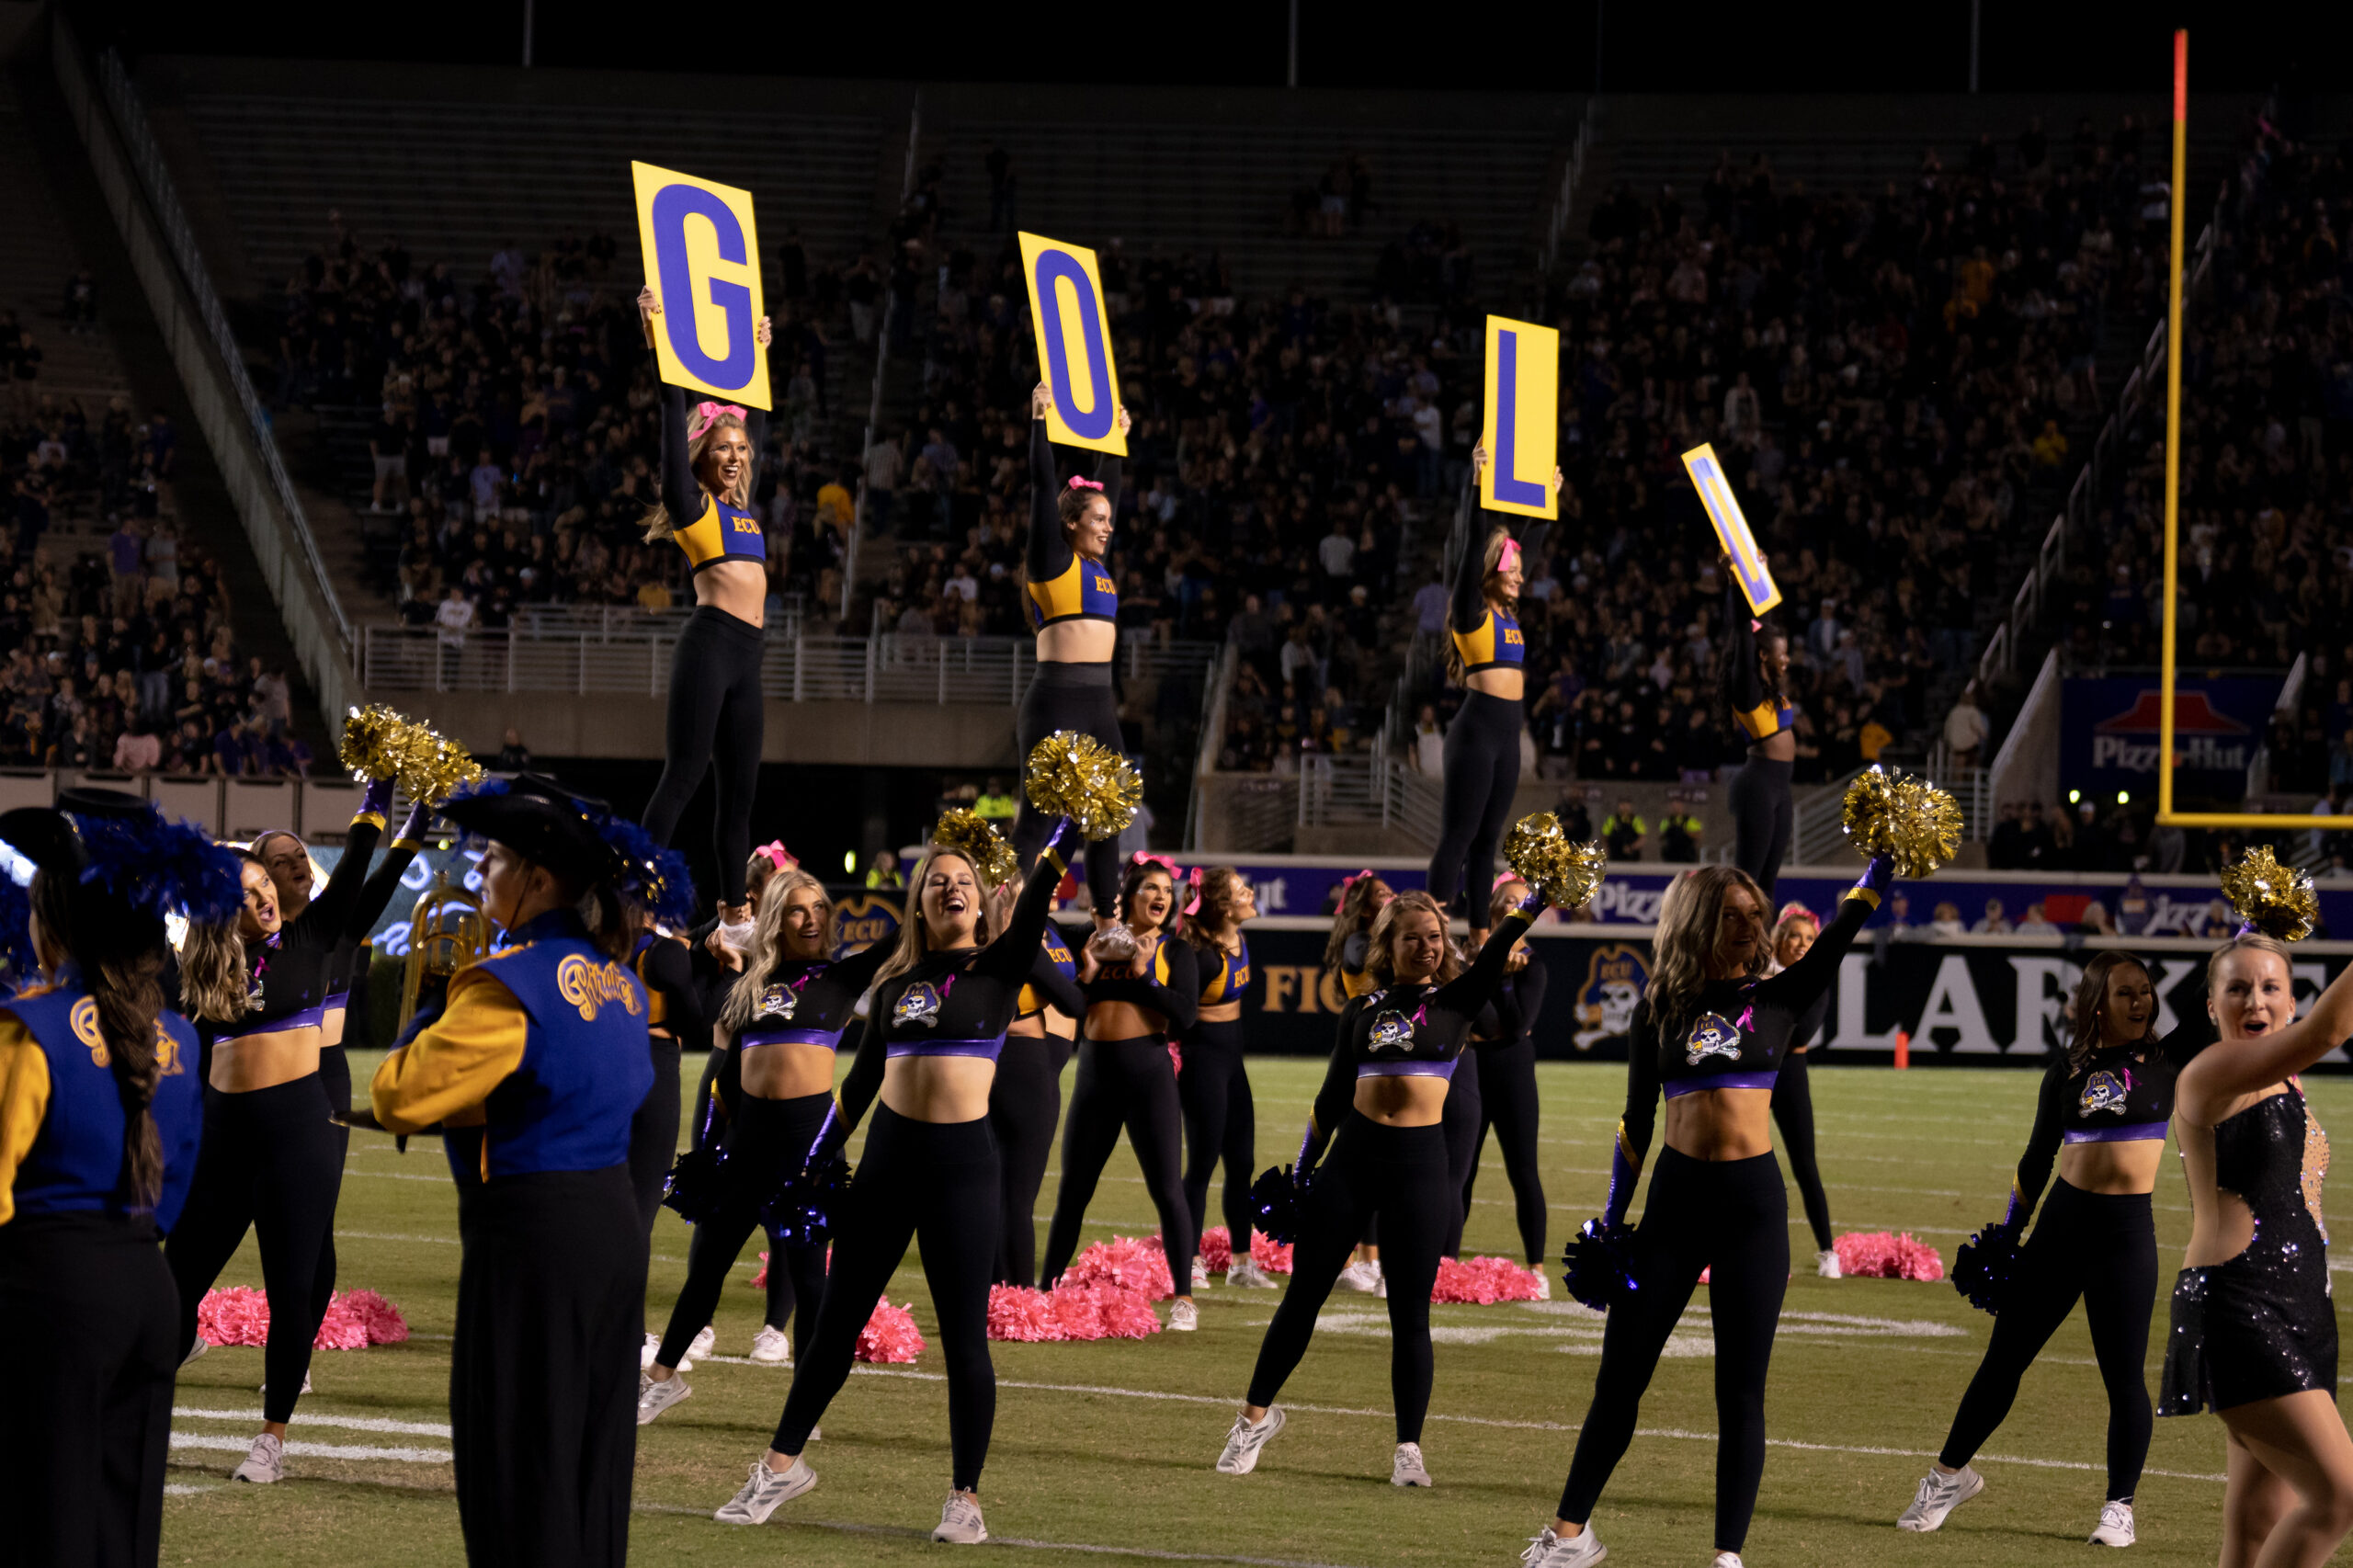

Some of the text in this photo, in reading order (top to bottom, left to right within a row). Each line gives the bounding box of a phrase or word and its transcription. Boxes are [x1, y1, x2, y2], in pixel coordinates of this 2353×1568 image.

[652, 184, 756, 391] G
[1035, 249, 1114, 439] O
[1494, 329, 1546, 508] L
[730, 516, 761, 535] ECU
[1094, 574, 1116, 595] ECU
[1504, 628, 1525, 645] ECU
[2092, 736, 2182, 774] Pizz
[1591, 881, 1665, 923] Pizz
[842, 920, 887, 942] ECU
[1048, 948, 1073, 963] ECU
[1233, 965, 1250, 989] ECU
